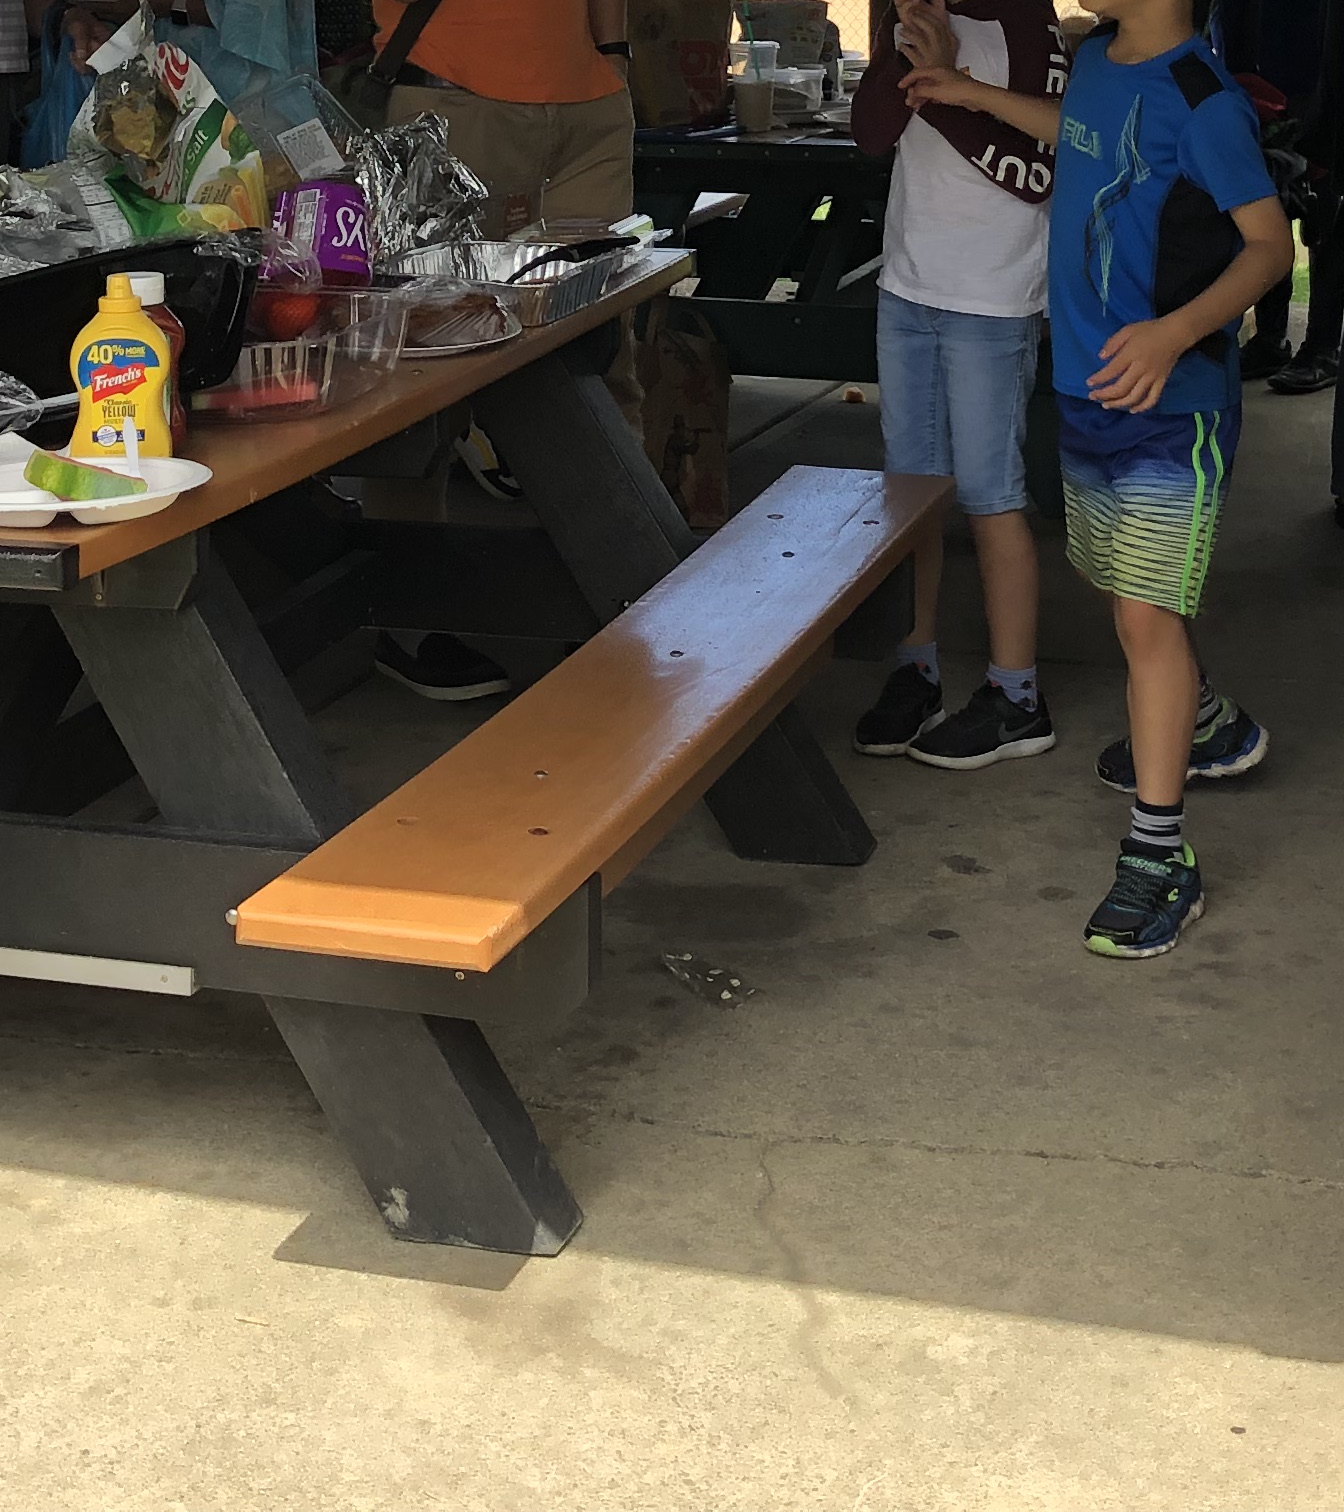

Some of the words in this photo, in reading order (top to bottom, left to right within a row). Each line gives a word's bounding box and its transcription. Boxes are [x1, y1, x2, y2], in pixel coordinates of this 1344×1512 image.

[186, 129, 209, 165] Salt
[1062, 116, 1103, 161] FILA
[87, 344, 124, 364] 40%
[94, 367, 142, 392] French's
[102, 403, 136, 418] YELLOW
